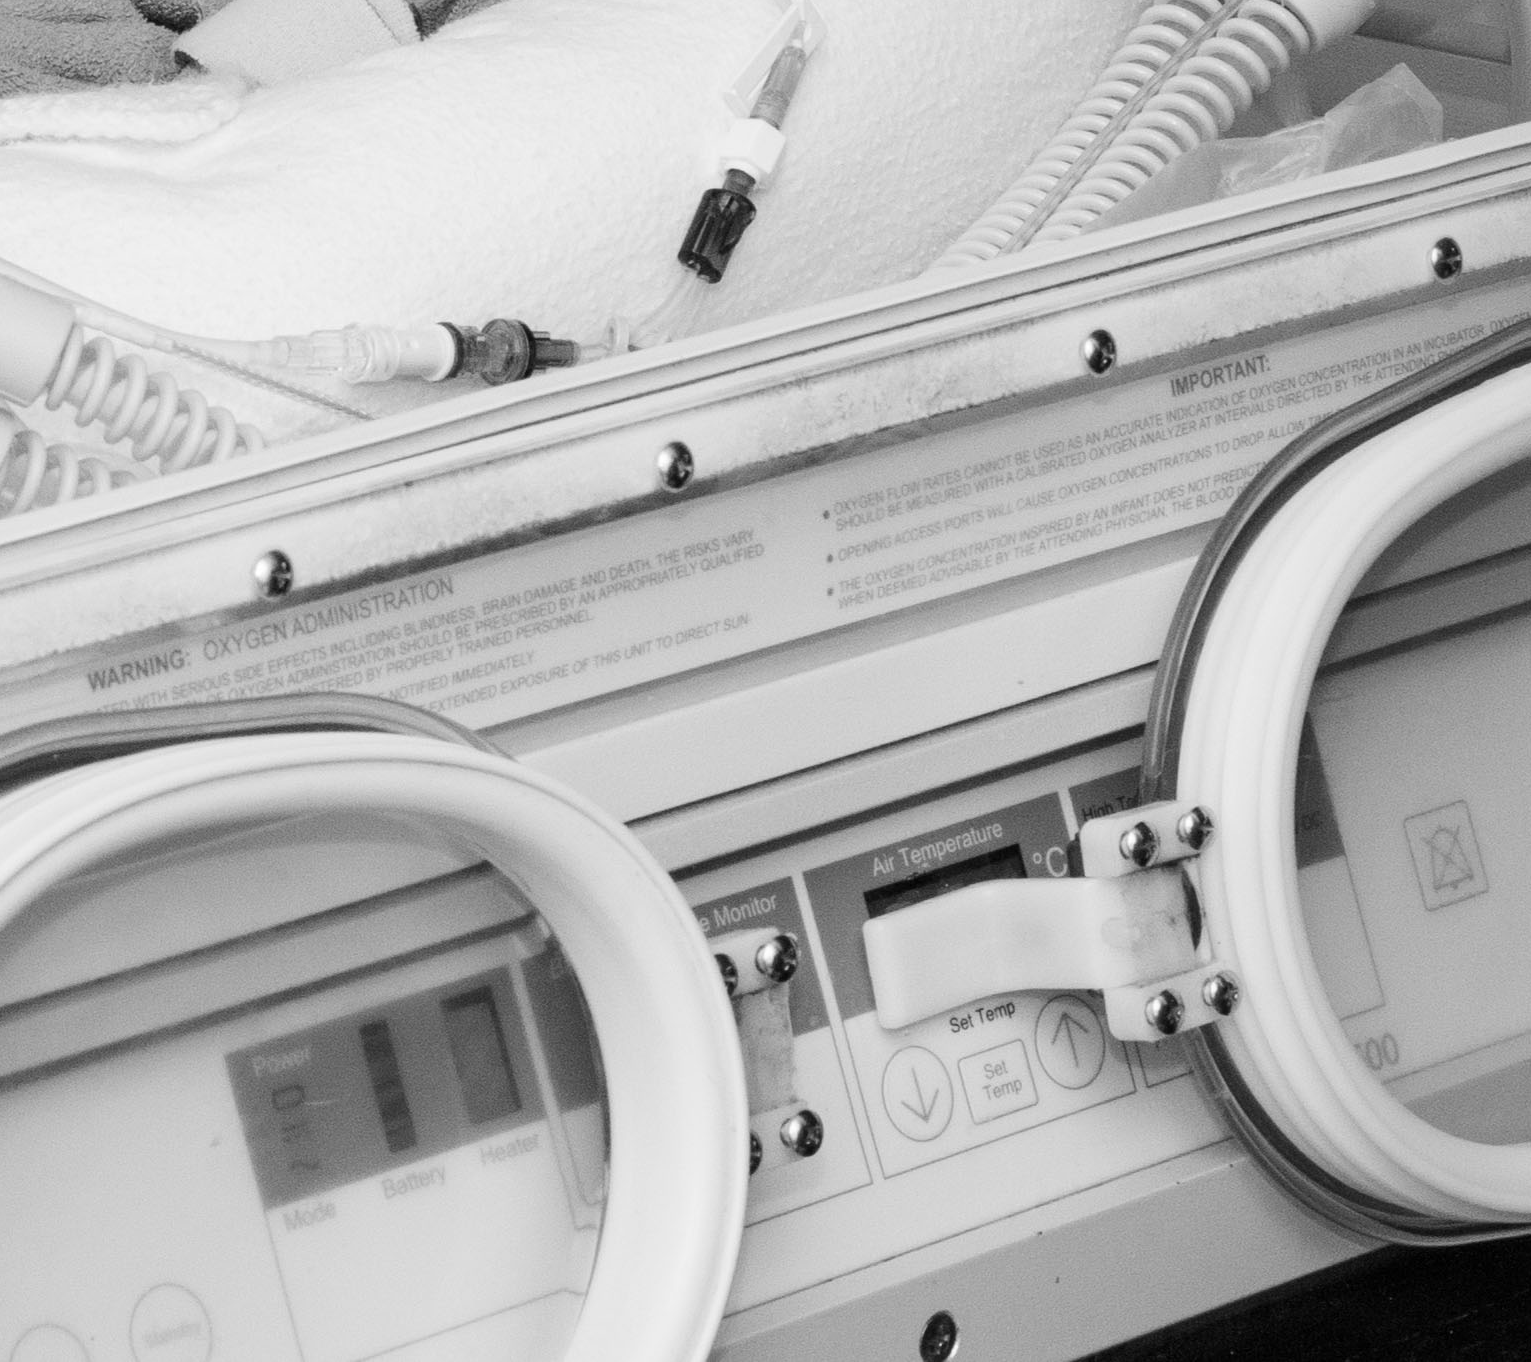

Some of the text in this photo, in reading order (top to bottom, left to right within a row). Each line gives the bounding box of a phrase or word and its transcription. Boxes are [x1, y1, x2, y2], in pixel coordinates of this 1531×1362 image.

[1170, 355, 1270, 396] IMPORTANT:
[86, 577, 455, 692] WARNING: OXYGEN ADMINISTRATION
[872, 856, 895, 877] Air
[898, 821, 1003, 867] Temperature
[713, 893, 778, 927] Monitor
[949, 1001, 1016, 1034] Set Temp
[983, 1060, 1008, 1079] Set
[982, 1079, 1023, 1101] Temp
[478, 1132, 540, 1166] Heater
[380, 1165, 447, 1201] Battery
[282, 1200, 337, 1233] Mode
